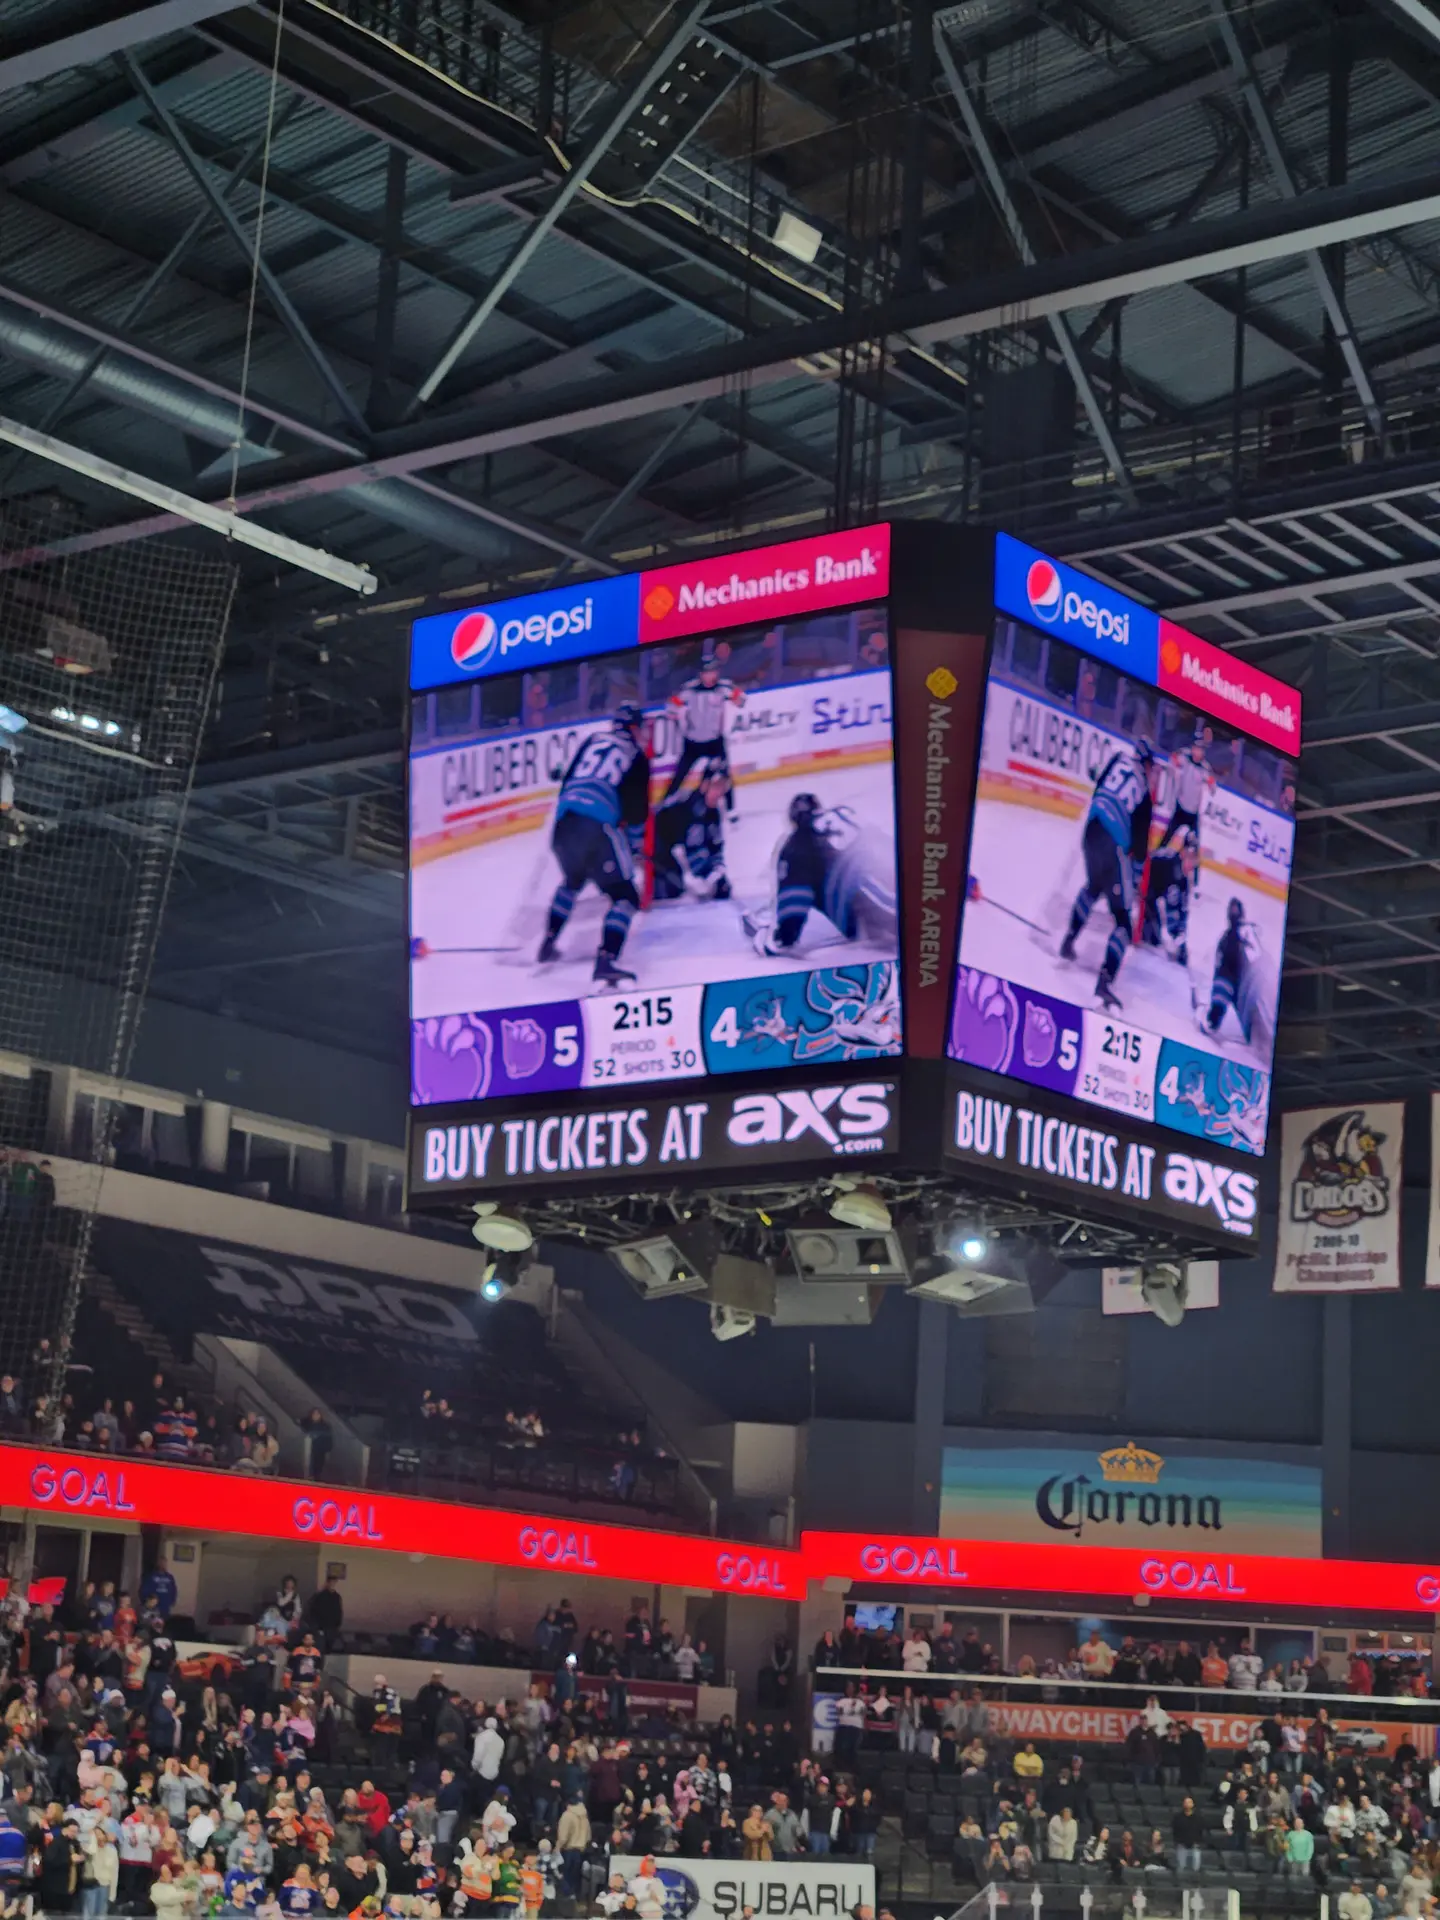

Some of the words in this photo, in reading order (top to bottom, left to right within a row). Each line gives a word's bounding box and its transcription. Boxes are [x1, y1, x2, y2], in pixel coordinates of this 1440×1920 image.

[678, 565, 808, 612] Mechanics
[815, 548, 876, 586] Bank
[501, 598, 592, 655] pepsi
[1064, 591, 1129, 645] pepsi
[1181, 651, 1258, 714] Mechanics
[1260, 691, 1295, 732] Bank
[1010, 697, 1082, 775] CALIBER
[442, 739, 538, 806] CALIBER
[924, 703, 953, 835] Mechanics
[922, 842, 949, 902] Bank
[918, 907, 941, 988] ARENA
[613, 996, 673, 1031] 2:15
[710, 1006, 741, 1048] 4
[553, 1025, 579, 1067] 5
[593, 1059, 616, 1078] 52
[624, 1059, 664, 1075] SHOTS
[671, 1049, 696, 1069] 30
[610, 1039, 656, 1054] PERIOD
[1057, 1028, 1079, 1071] 5
[1102, 1025, 1141, 1063] 2:15
[1083, 1074, 1100, 1095] 52
[1133, 1090, 1150, 1111] 30
[1159, 1066, 1179, 1104] 4
[424, 1123, 494, 1182] BUY
[501, 1109, 649, 1176] TICKETS
[659, 1104, 708, 1163] AT
[727, 1083, 890, 1145] axs
[956, 1090, 1012, 1159] BUY
[1016, 1107, 1119, 1190] TICKETS
[1121, 1142, 1156, 1200] AT
[1164, 1153, 1257, 1220] axs
[30, 1463, 135, 1512] GOAL
[1036, 1473, 1224, 1538] Corona
[292, 1496, 384, 1541] GOAL
[518, 1525, 598, 1570] GOAL
[859, 1544, 969, 1579] GOAL
[716, 1552, 786, 1591] GOAL
[1139, 1558, 1246, 1594] GOAL
[712, 1880, 862, 1916] SUBARU
